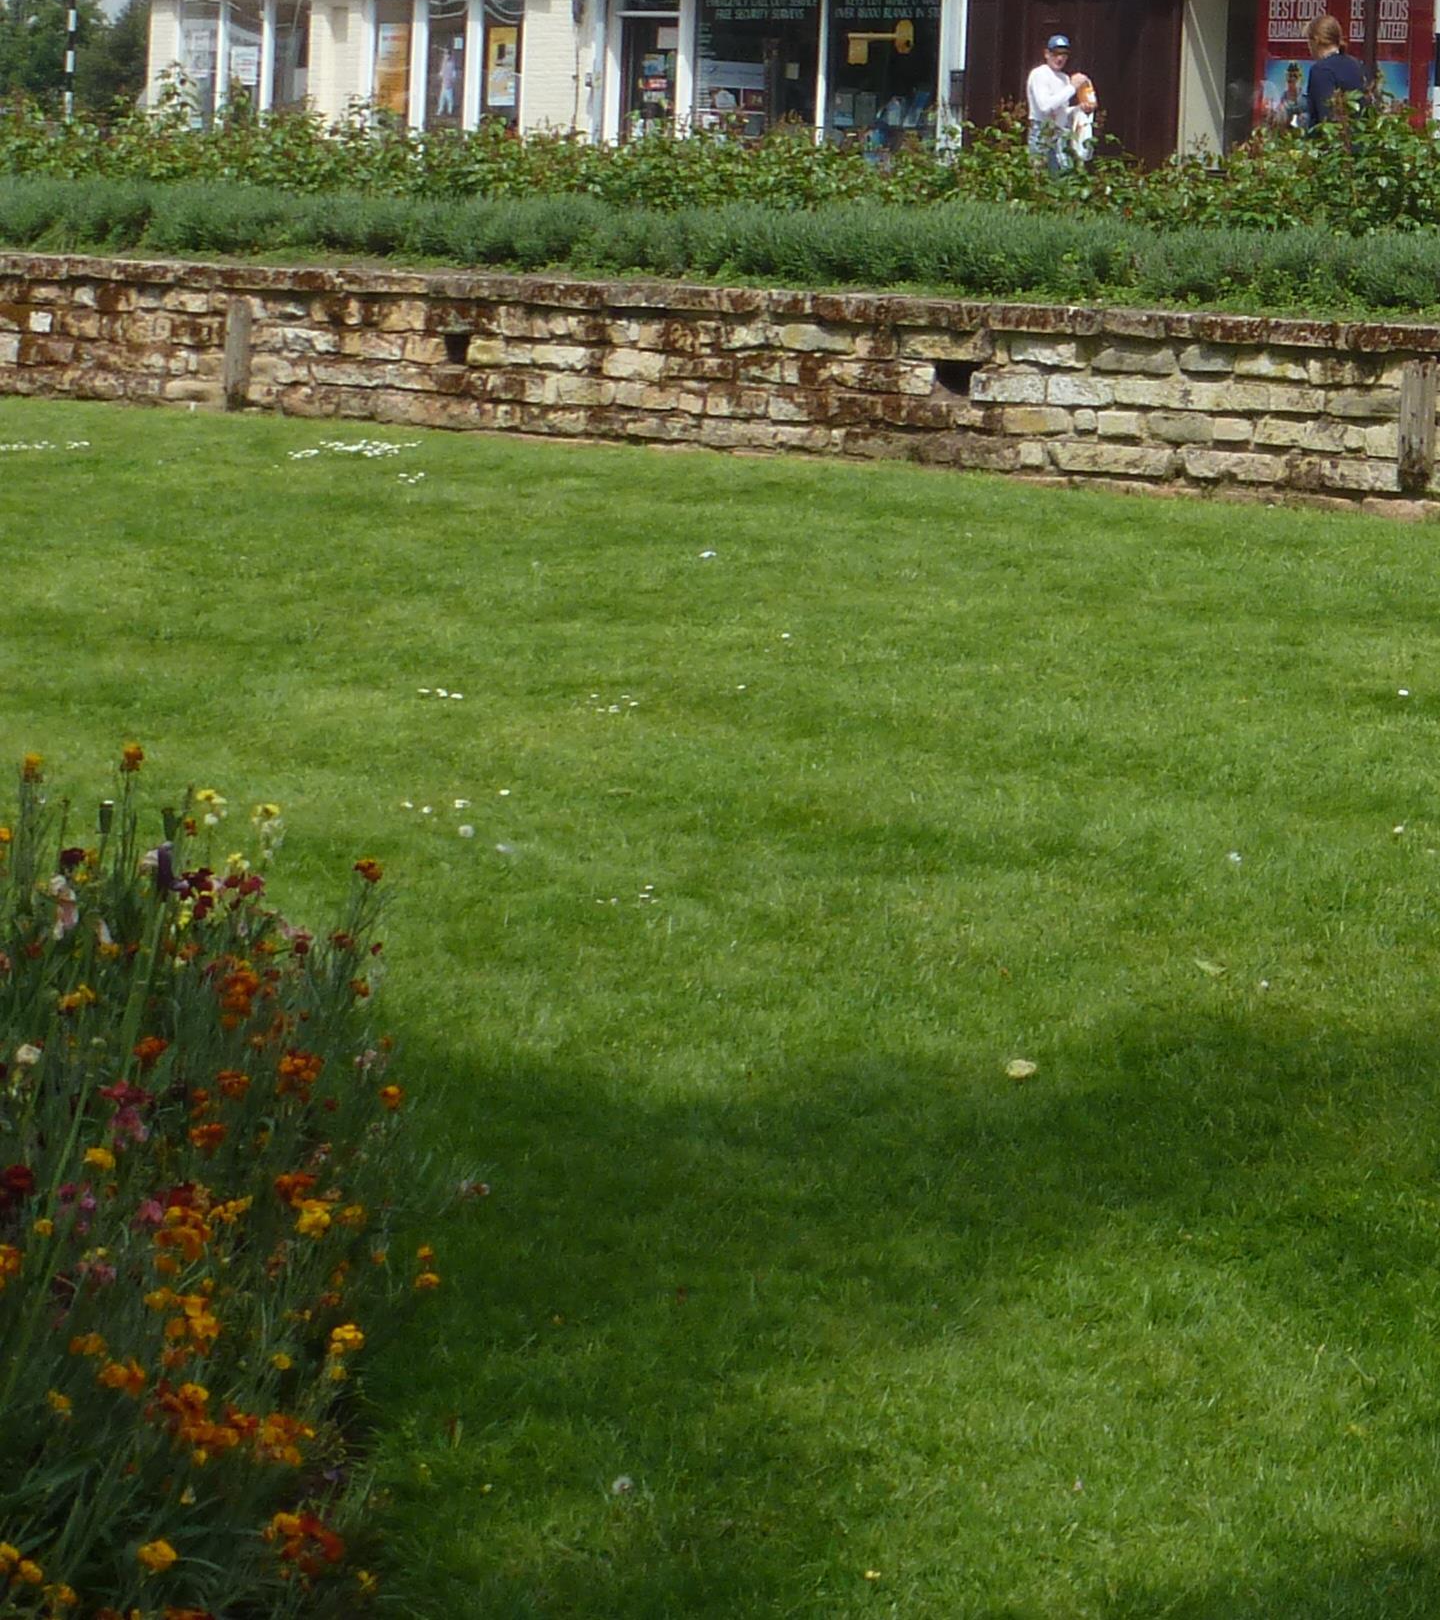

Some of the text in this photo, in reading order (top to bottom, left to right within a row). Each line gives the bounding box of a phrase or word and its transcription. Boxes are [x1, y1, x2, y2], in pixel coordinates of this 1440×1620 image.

[1269, 0, 1327, 20] BEST ODDS
[1379, 0, 1409, 20] ODDS
